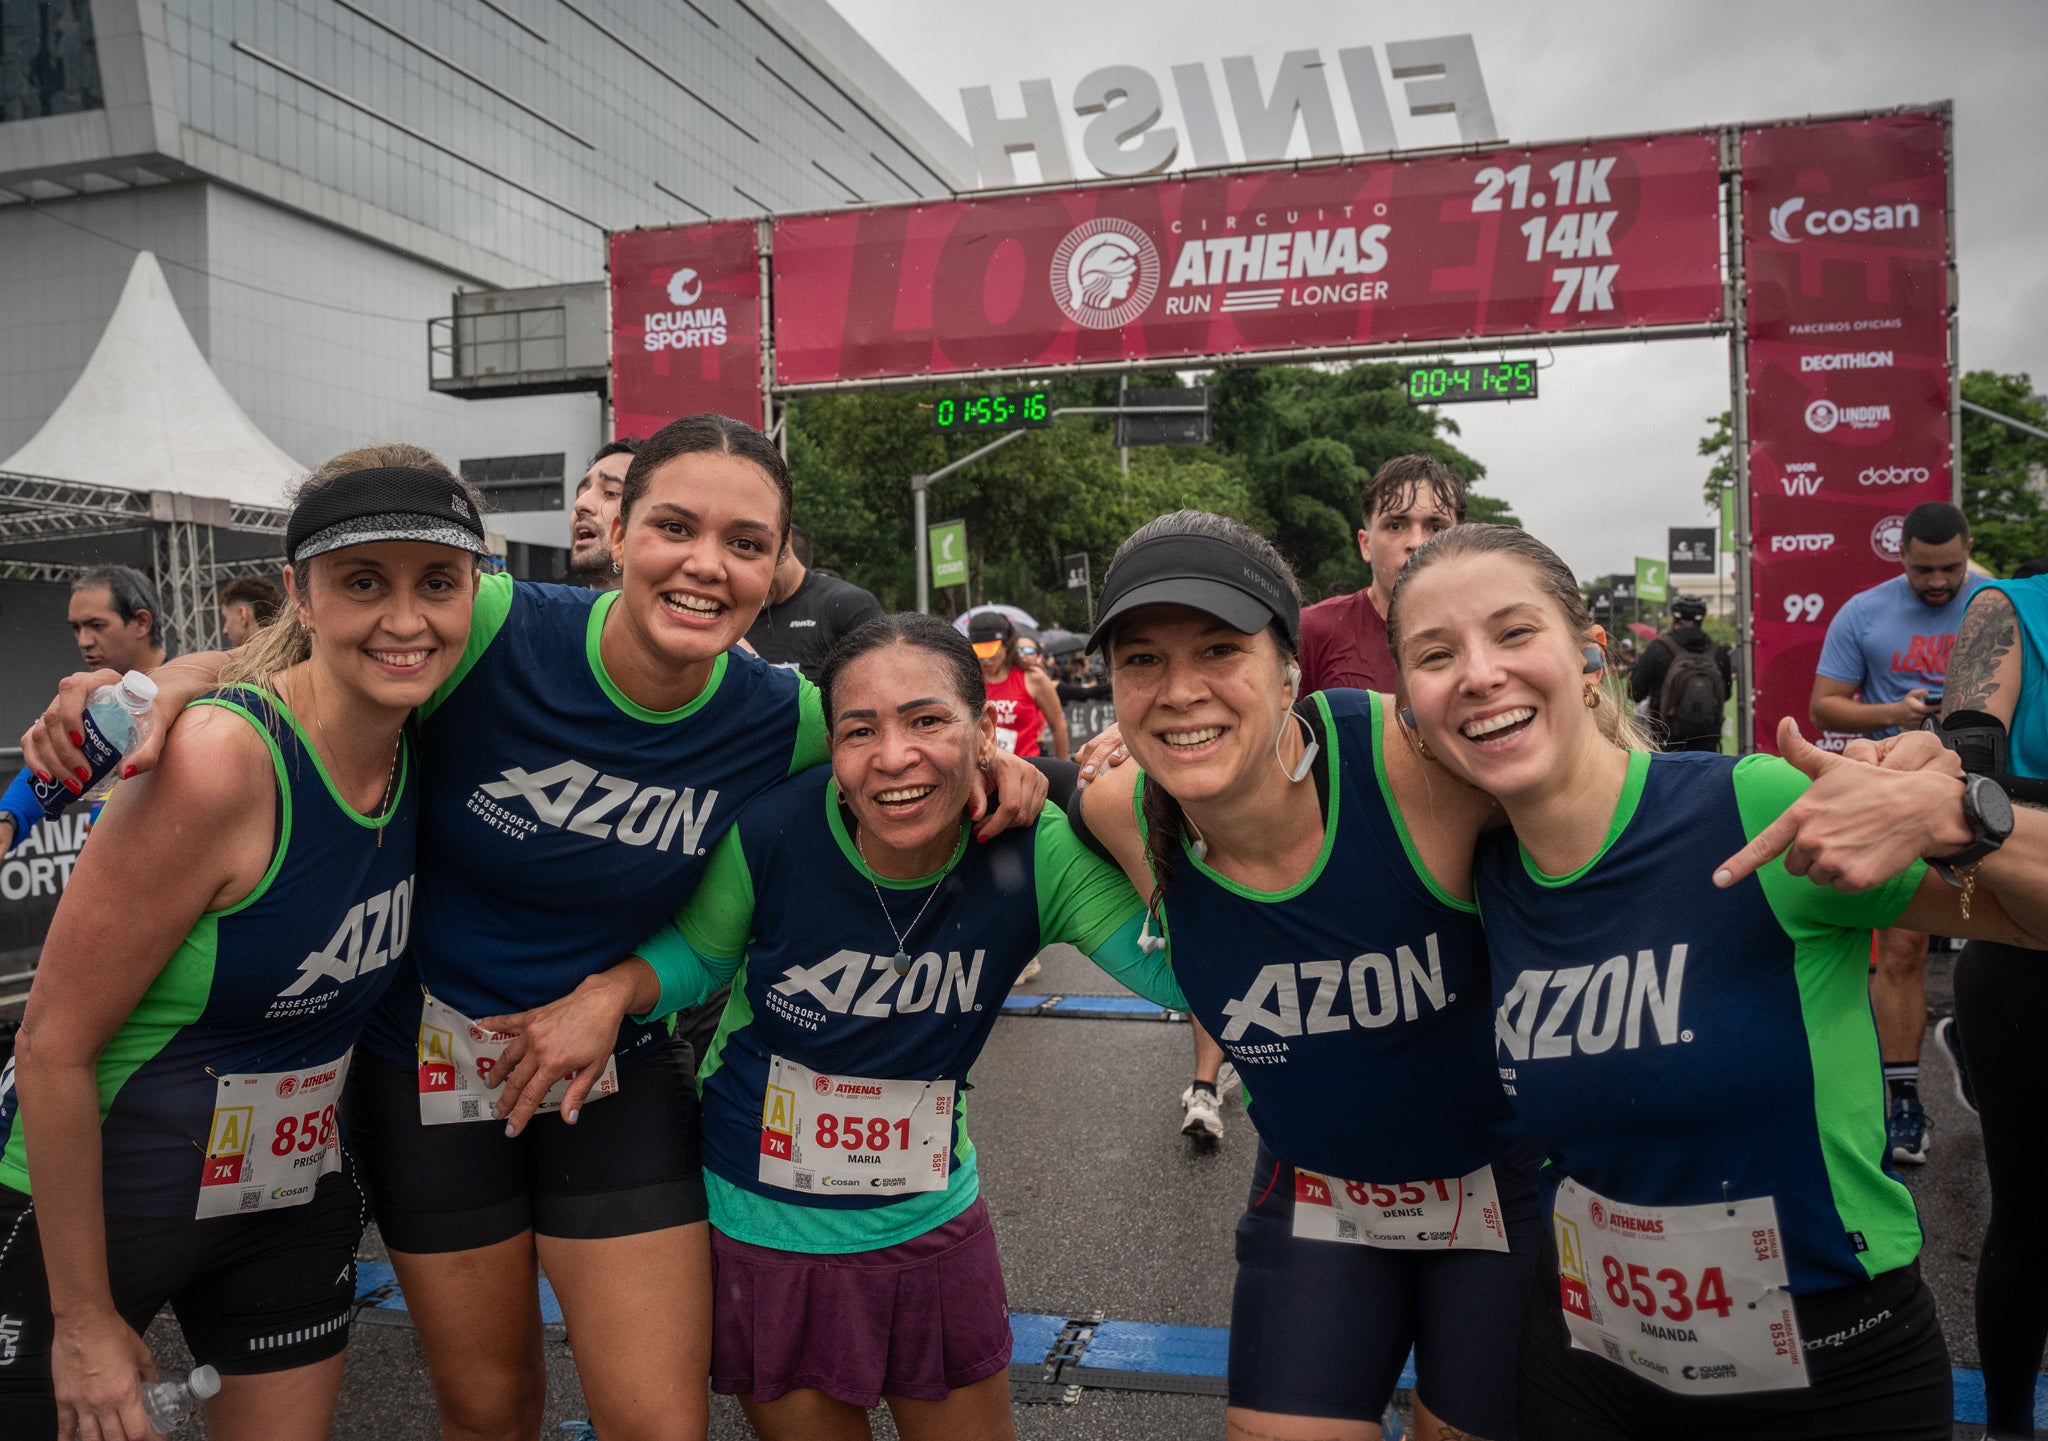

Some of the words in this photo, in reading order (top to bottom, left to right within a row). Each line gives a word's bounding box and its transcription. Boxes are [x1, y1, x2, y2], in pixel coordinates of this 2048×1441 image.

[1471, 157, 1617, 213] 21.1K
[1171, 202, 1388, 233] CIRCUITO
[1804, 203, 1919, 235] cosan
[1520, 210, 1619, 262] 14K
[1169, 223, 1392, 288] ATHENAS
[1165, 294, 1211, 316] RUN
[1290, 281, 1389, 306] LONGER
[1550, 264, 1620, 314] 7K
[644, 307, 727, 332] IGUANA
[1789, 322, 1850, 334] PARCEIROS
[1853, 318, 1902, 330] OFICIAIS
[644, 326, 728, 352] SPORTS
[1801, 351, 1893, 372] DECATHLON
[1410, 362, 1531, 398] 00:41:25
[937, 393, 1047, 427] 01:55:16
[1839, 405, 1890, 423] LINDOYA
[1858, 466, 1930, 486] dobro
[1243, 567, 1280, 600] KIPRUN
[1783, 594, 1824, 622] 99
[84, 719, 112, 756] CARBS
[466, 799, 525, 841] ESPORTIVA
[472, 791, 538, 834] ASSESSORIA
[478, 759, 719, 855] AZON
[276, 874, 415, 997] AZO
[771, 949, 986, 1018] AZON
[1220, 932, 1447, 1041] AZON
[270, 990, 339, 1009] ASSESSORIA
[766, 992, 827, 1023] ASSESSORIA
[1495, 944, 1688, 1060] AZON
[765, 1000, 818, 1031] ESPORTIVA
[429, 1033, 446, 1060] A
[301, 1069, 337, 1089] ATHENAS
[429, 1071, 448, 1086] 7K
[835, 1083, 882, 1096] ATHENAS
[770, 1095, 786, 1128] A
[935, 1096, 945, 1115] 8581
[218, 1114, 239, 1150] A
[271, 1095, 341, 1157] 858
[815, 1113, 910, 1151] 8581
[769, 1138, 785, 1154] 7K
[848, 1154, 881, 1164] MARIA
[213, 1164, 234, 1179] 7K
[932, 1153, 942, 1172] 8581
[280, 1185, 308, 1198] cosan
[1305, 1183, 1324, 1199] 7K
[1344, 1178, 1449, 1207] 8551
[1383, 1207, 1424, 1218] DENISE
[1483, 1207, 1495, 1229] 8551
[1609, 1212, 1664, 1234] ATHENAS
[1373, 1232, 1405, 1241] cosan
[1561, 1225, 1578, 1269] A
[1752, 1229, 1769, 1262] 8534
[1566, 1288, 1585, 1311] 7K
[1602, 1254, 1734, 1322] 8534
[1640, 1320, 1698, 1342] AMANDA
[1769, 1322, 1788, 1356] 8534
[1638, 1355, 1669, 1375] cosan
[1699, 1363, 1735, 1373] IGUANA
[1700, 1370, 1737, 1380] SPORTS
